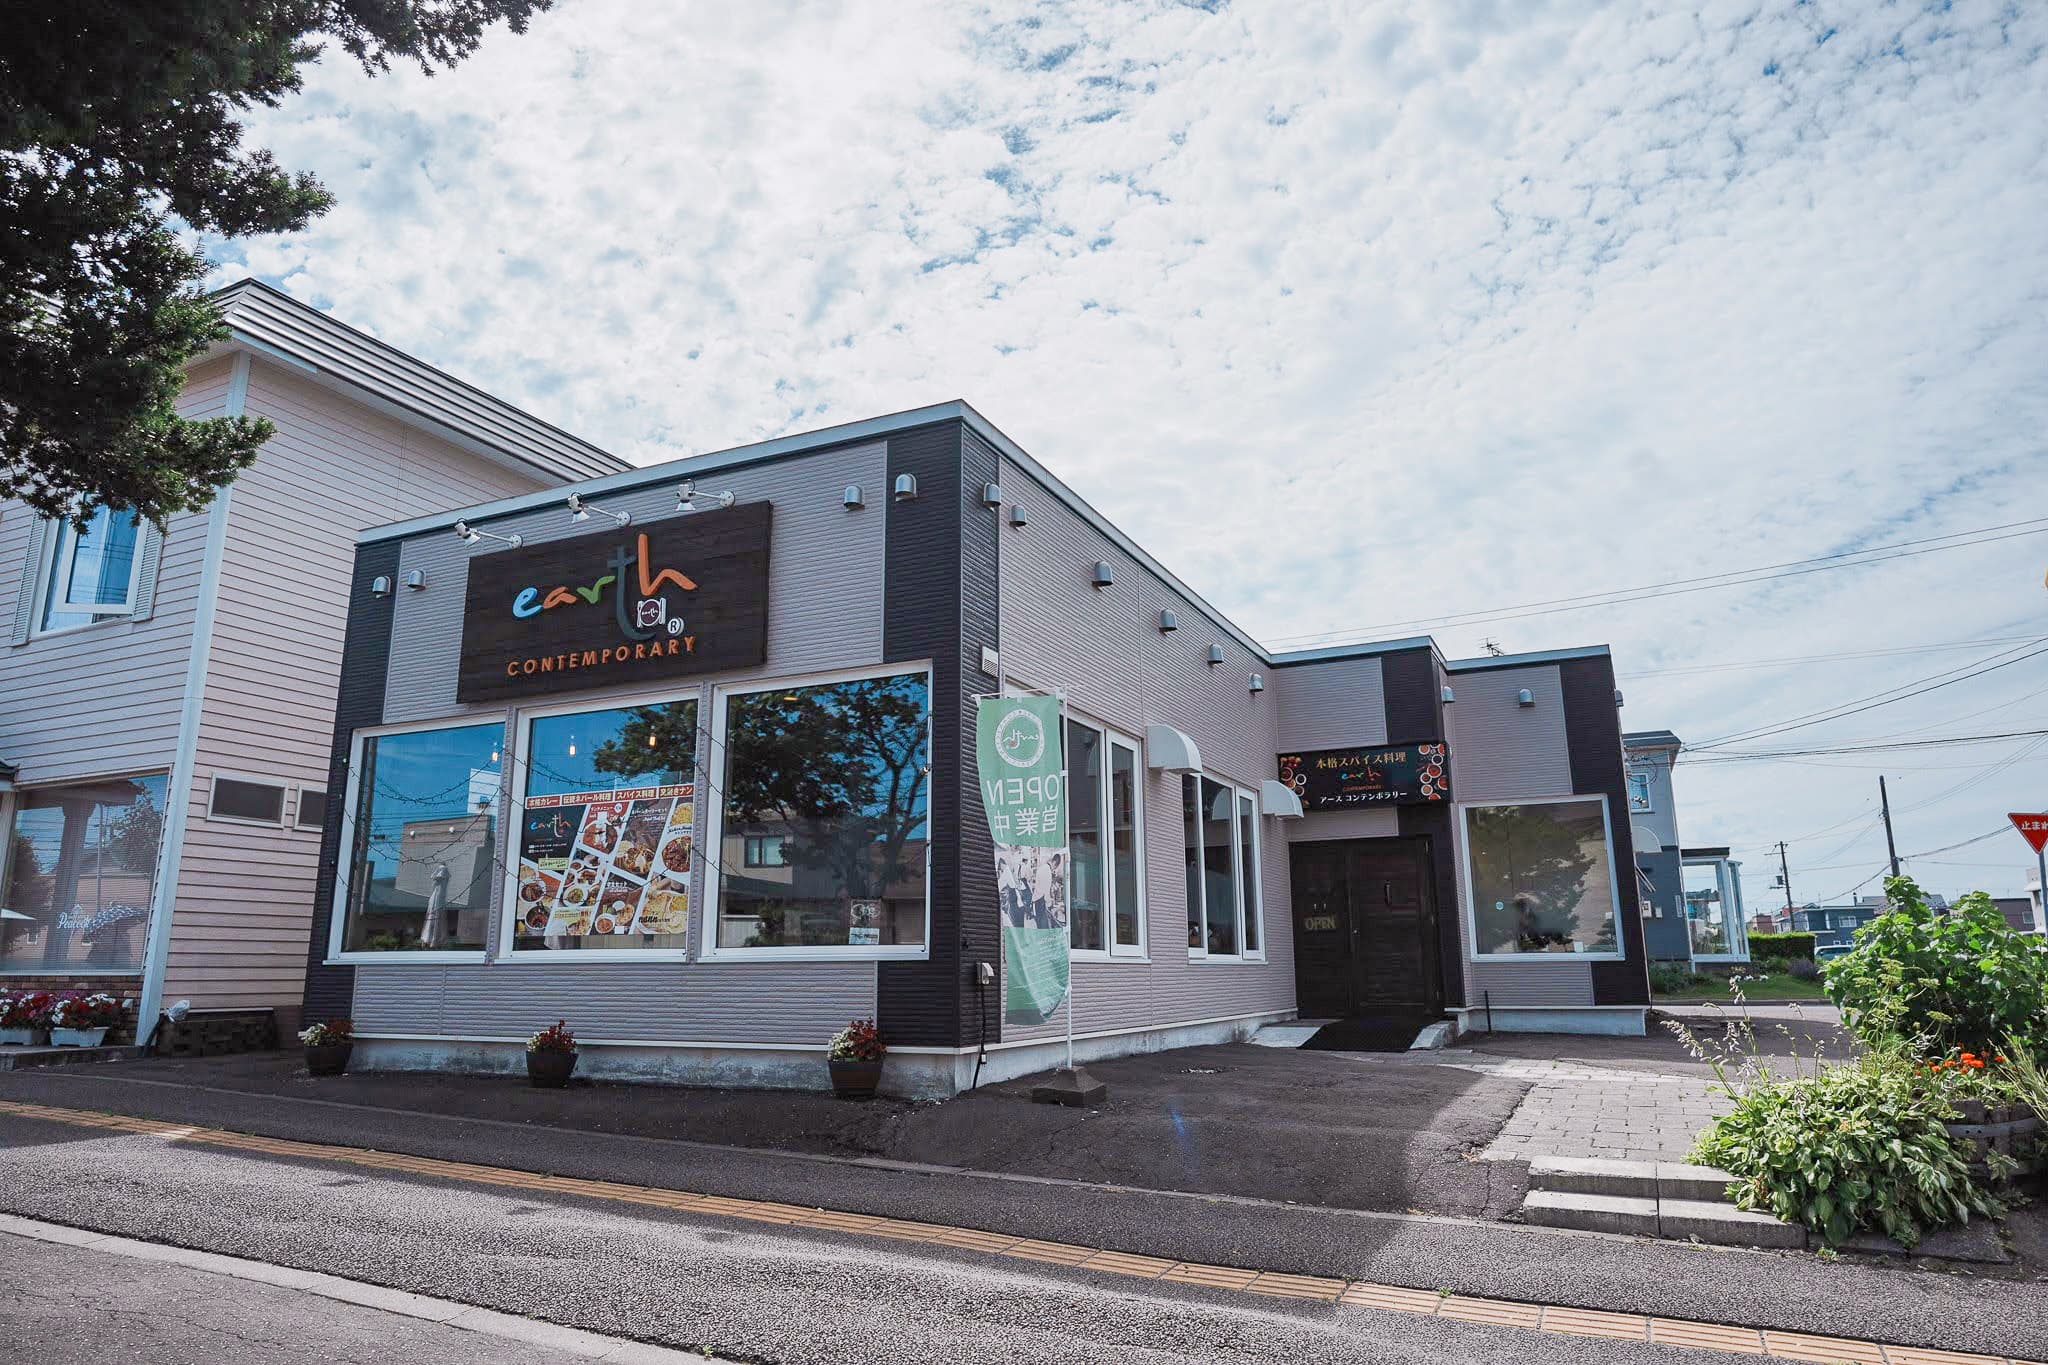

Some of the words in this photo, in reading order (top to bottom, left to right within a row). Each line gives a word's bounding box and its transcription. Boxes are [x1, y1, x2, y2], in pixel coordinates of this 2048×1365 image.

[513, 534, 699, 641] earth
[507, 635, 698, 677] CONTEMPORARY
[1316, 751, 1406, 769] 本格スパイス料理
[1341, 767, 1382, 780] earh
[1320, 795, 1342, 804] アース
[1305, 917, 1336, 930] OPEN
